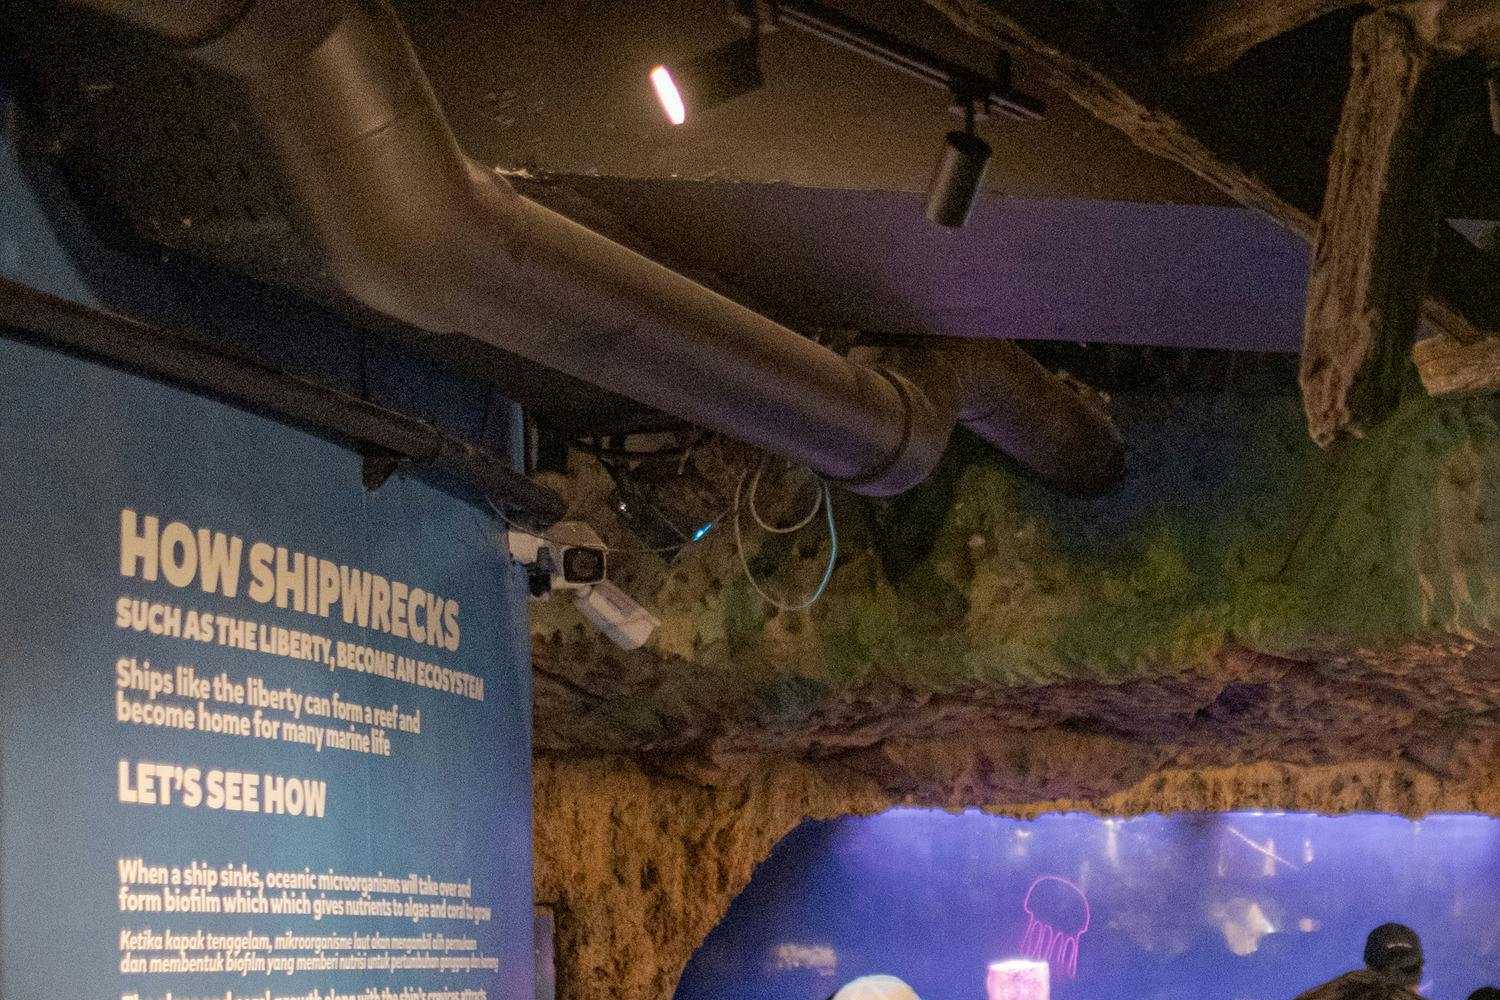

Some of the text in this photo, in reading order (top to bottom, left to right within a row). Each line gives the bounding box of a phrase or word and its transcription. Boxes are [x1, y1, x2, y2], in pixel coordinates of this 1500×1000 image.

[120, 509, 460, 651] HOW SHIPWRECKS
[116, 597, 484, 701] SUCH AS THE LIBERTY, BECOME AN ECOSYSTEM
[115, 659, 420, 734] Ships like the liberty can form a reef and
[117, 691, 391, 756] become home for many marine life
[118, 761, 326, 818] LET'S SEE HOW
[119, 859, 471, 898] When a ship sinks, oceanic microorganisms will take over and
[119, 887, 162, 911] form
[163, 888, 220, 912] biofilm
[222, 890, 268, 913] which
[270, 891, 311, 914] which
[313, 893, 344, 920] gives
[346, 895, 392, 916] nutrients
[393, 899, 403, 917] to
[405, 896, 430, 922] algae
[430, 898, 446, 918] and
[447, 900, 466, 919] coral
[120, 929, 162, 950] Ketika
[207, 930, 272, 955] tenggelam,
[274, 930, 353, 955] mikroorganisme
[120, 952, 147, 973] dan
[150, 951, 223, 972] membentuk
[226, 951, 265, 976] biofilm
[266, 956, 294, 976] yang
[296, 951, 338, 970] memberi
